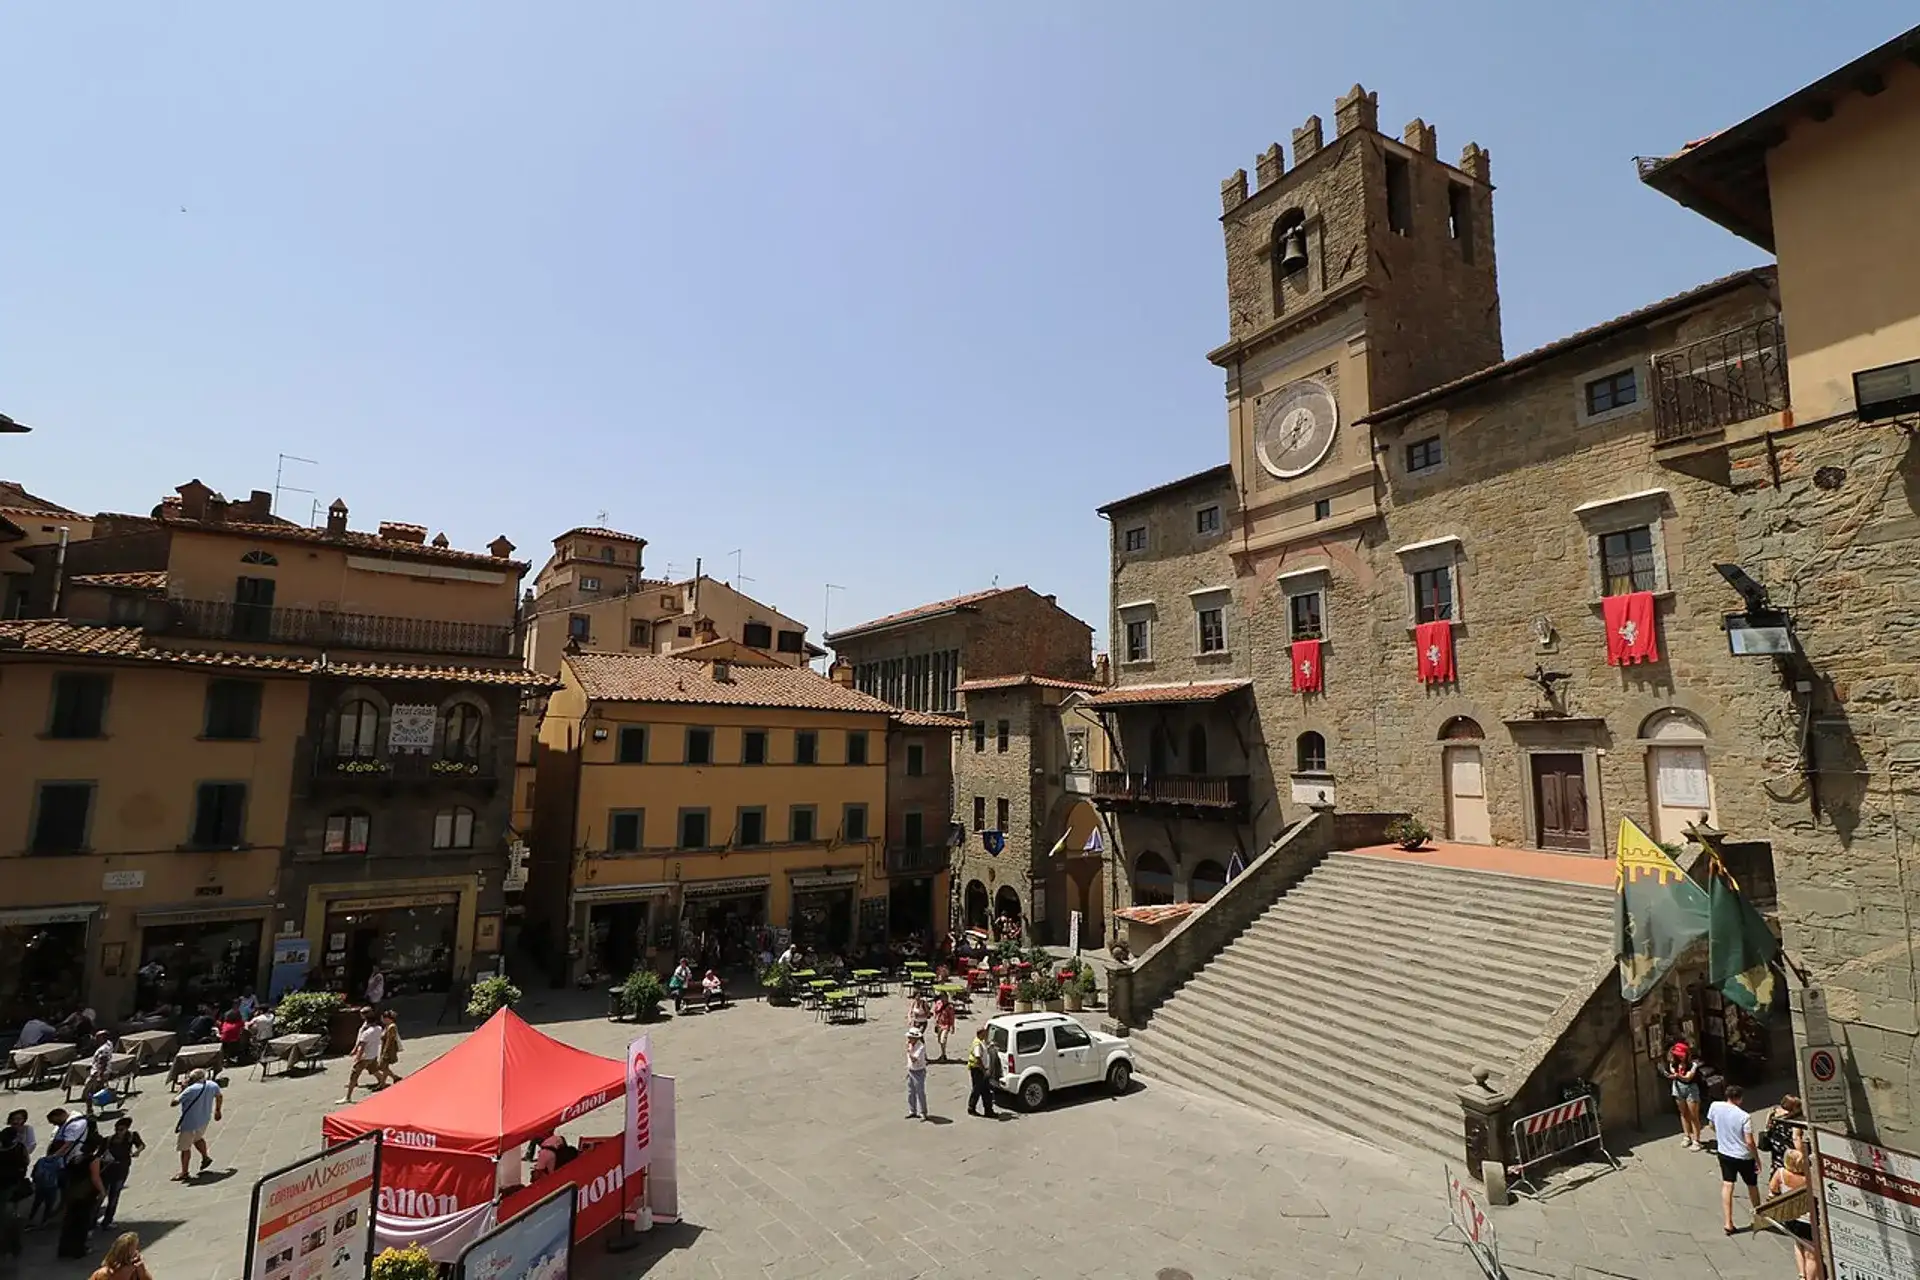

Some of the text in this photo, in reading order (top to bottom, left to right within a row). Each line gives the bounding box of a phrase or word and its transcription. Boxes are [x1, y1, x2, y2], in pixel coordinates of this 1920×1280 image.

[560, 1091, 606, 1121] Canon
[634, 1053, 649, 1150] Canon
[382, 1127, 437, 1148] Canon
[577, 1164, 623, 1213] non
[1822, 1158, 1870, 1181] Palazzo
[1875, 1174, 1920, 1197] Mancin
[377, 1186, 457, 1218] anon
